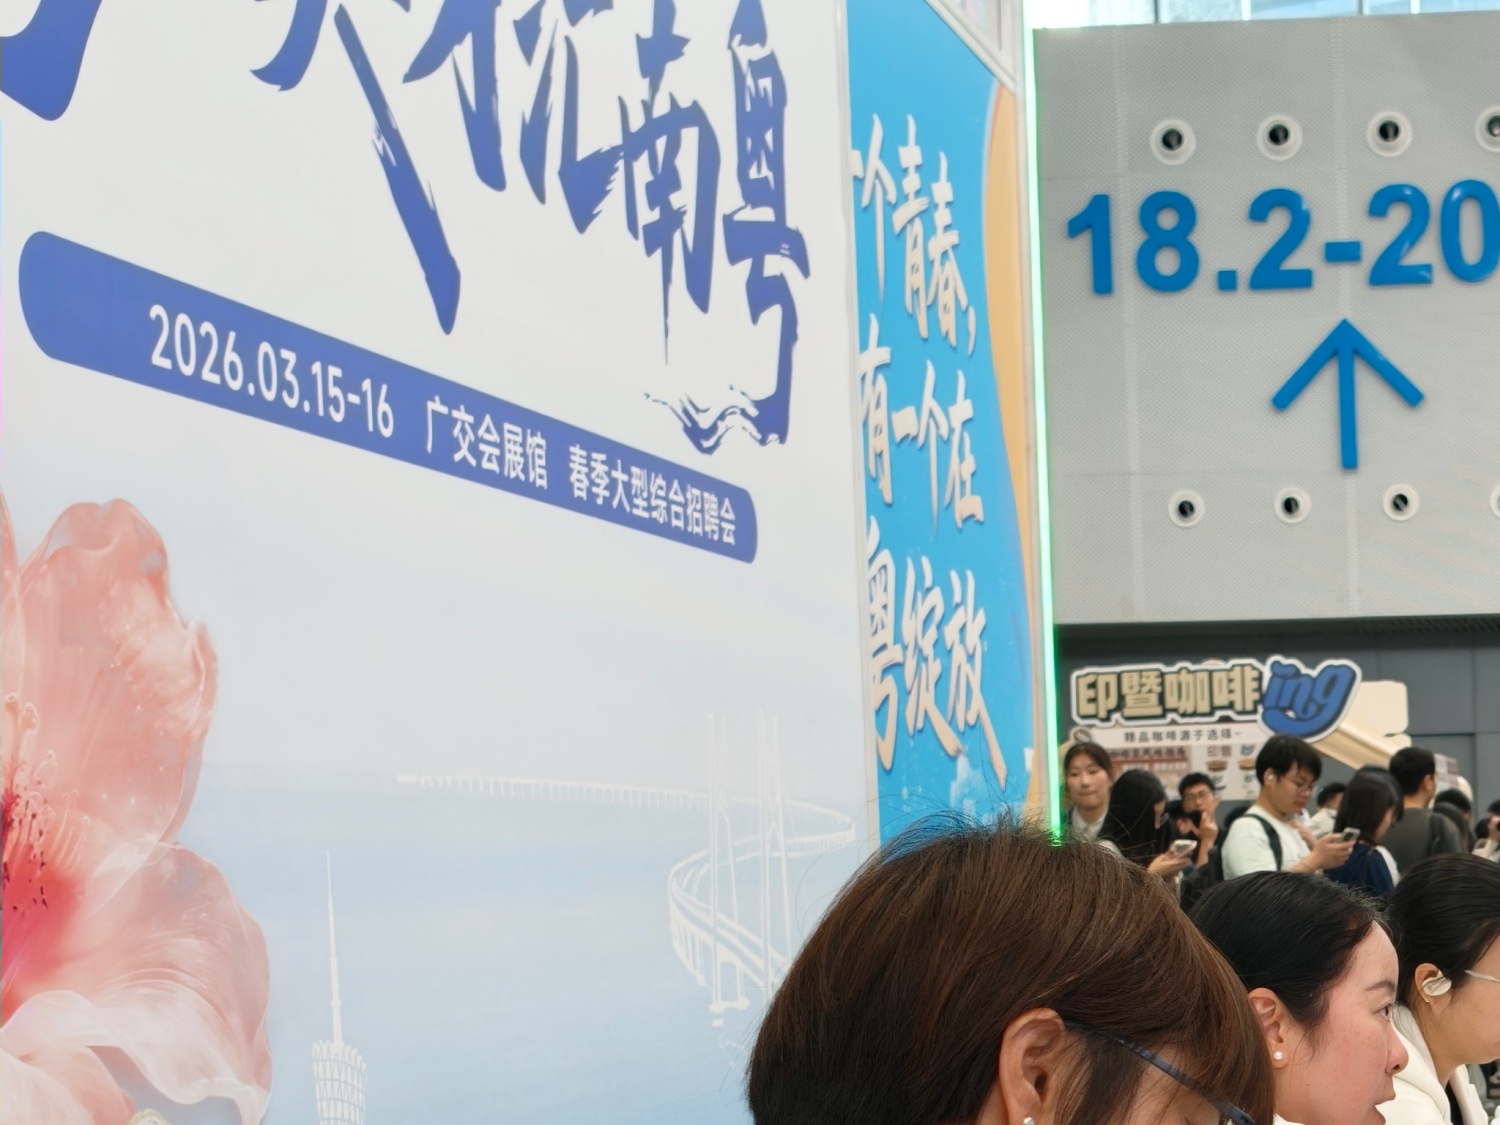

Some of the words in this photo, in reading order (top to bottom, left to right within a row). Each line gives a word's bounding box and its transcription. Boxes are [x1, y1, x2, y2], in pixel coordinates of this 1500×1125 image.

[149, 304, 394, 438] 2026.03.15-16
[426, 396, 548, 490] 广交会展馆
[569, 444, 737, 546] 春季大型综合招聘会
